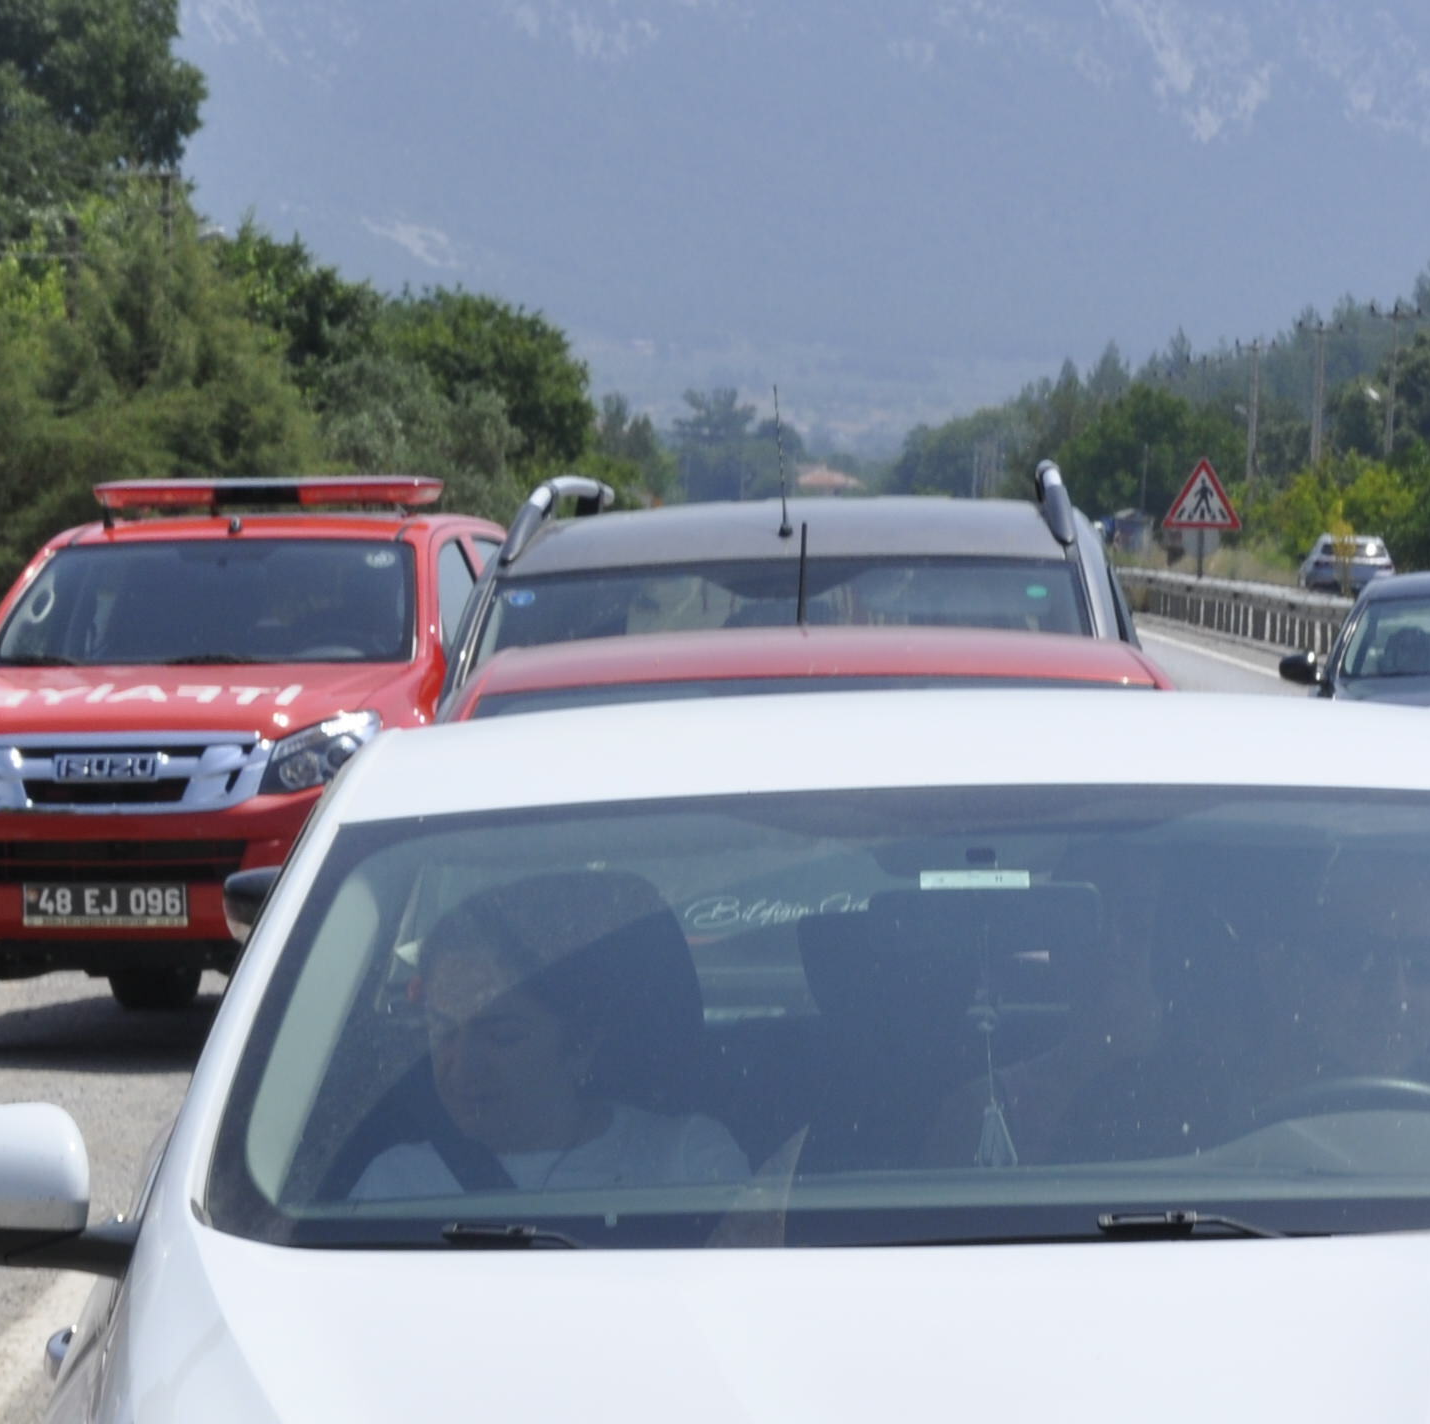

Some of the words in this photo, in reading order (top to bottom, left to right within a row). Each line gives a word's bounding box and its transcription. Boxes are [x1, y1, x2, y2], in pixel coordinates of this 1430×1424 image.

[39, 888, 72, 915] 48
[84, 888, 117, 915] EJ
[129, 888, 181, 915] 096
